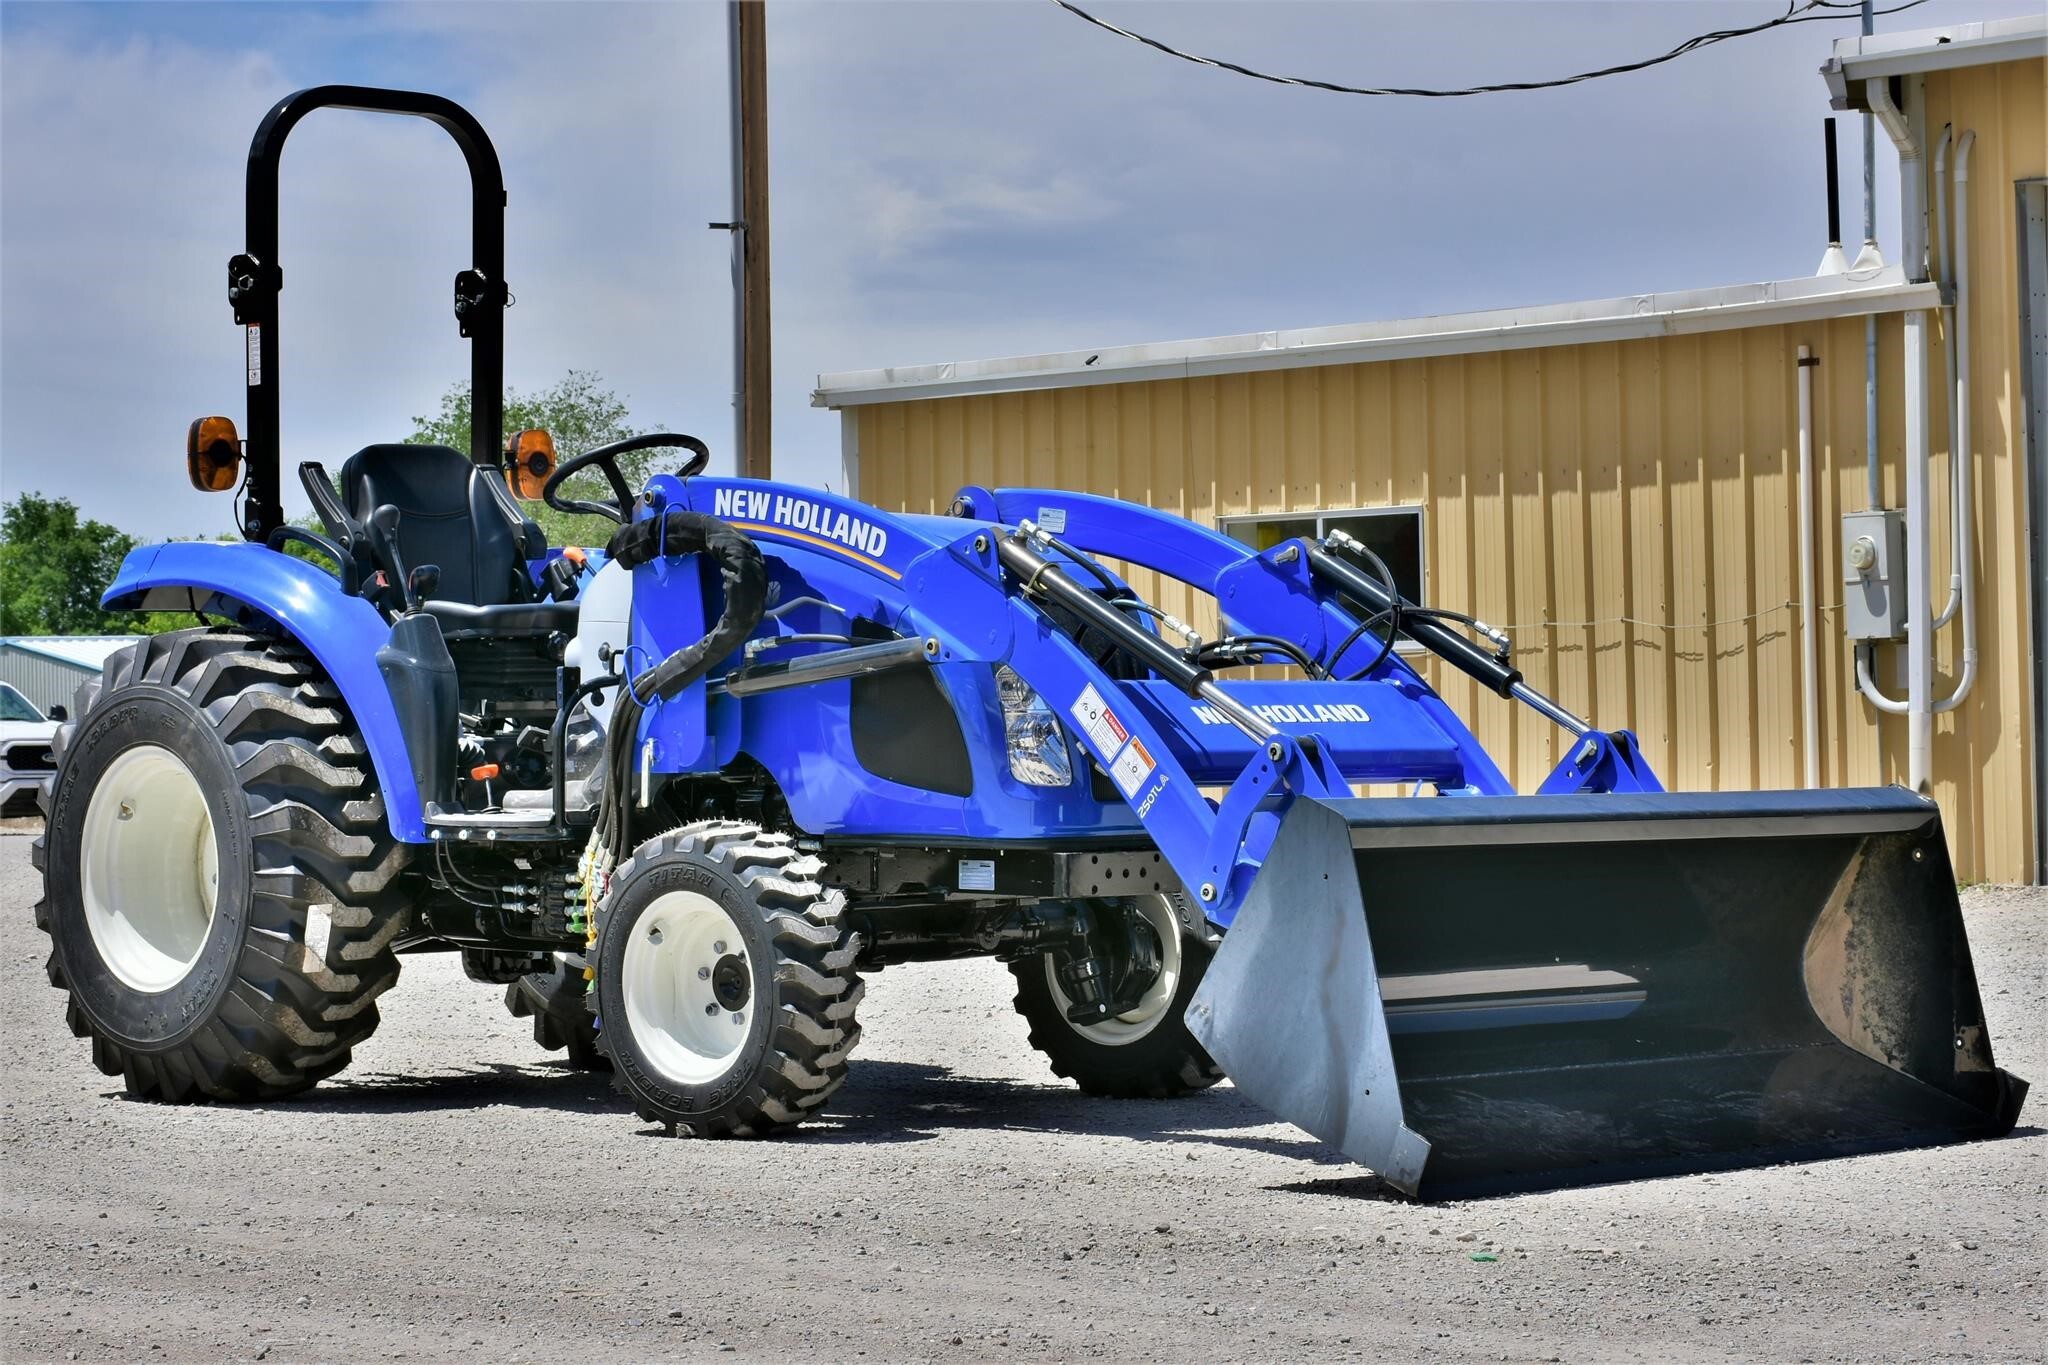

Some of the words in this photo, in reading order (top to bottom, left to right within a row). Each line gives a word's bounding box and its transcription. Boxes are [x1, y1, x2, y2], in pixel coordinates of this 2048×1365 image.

[714, 488, 771, 521] NEW
[773, 495, 887, 558] HOLLAND
[1107, 716, 1126, 740] DANGER
[1251, 704, 1371, 723] HOLLAND
[649, 866, 714, 889] TITAN
[620, 1051, 695, 1110] LOADER
[707, 1059, 751, 1104] TRAC
